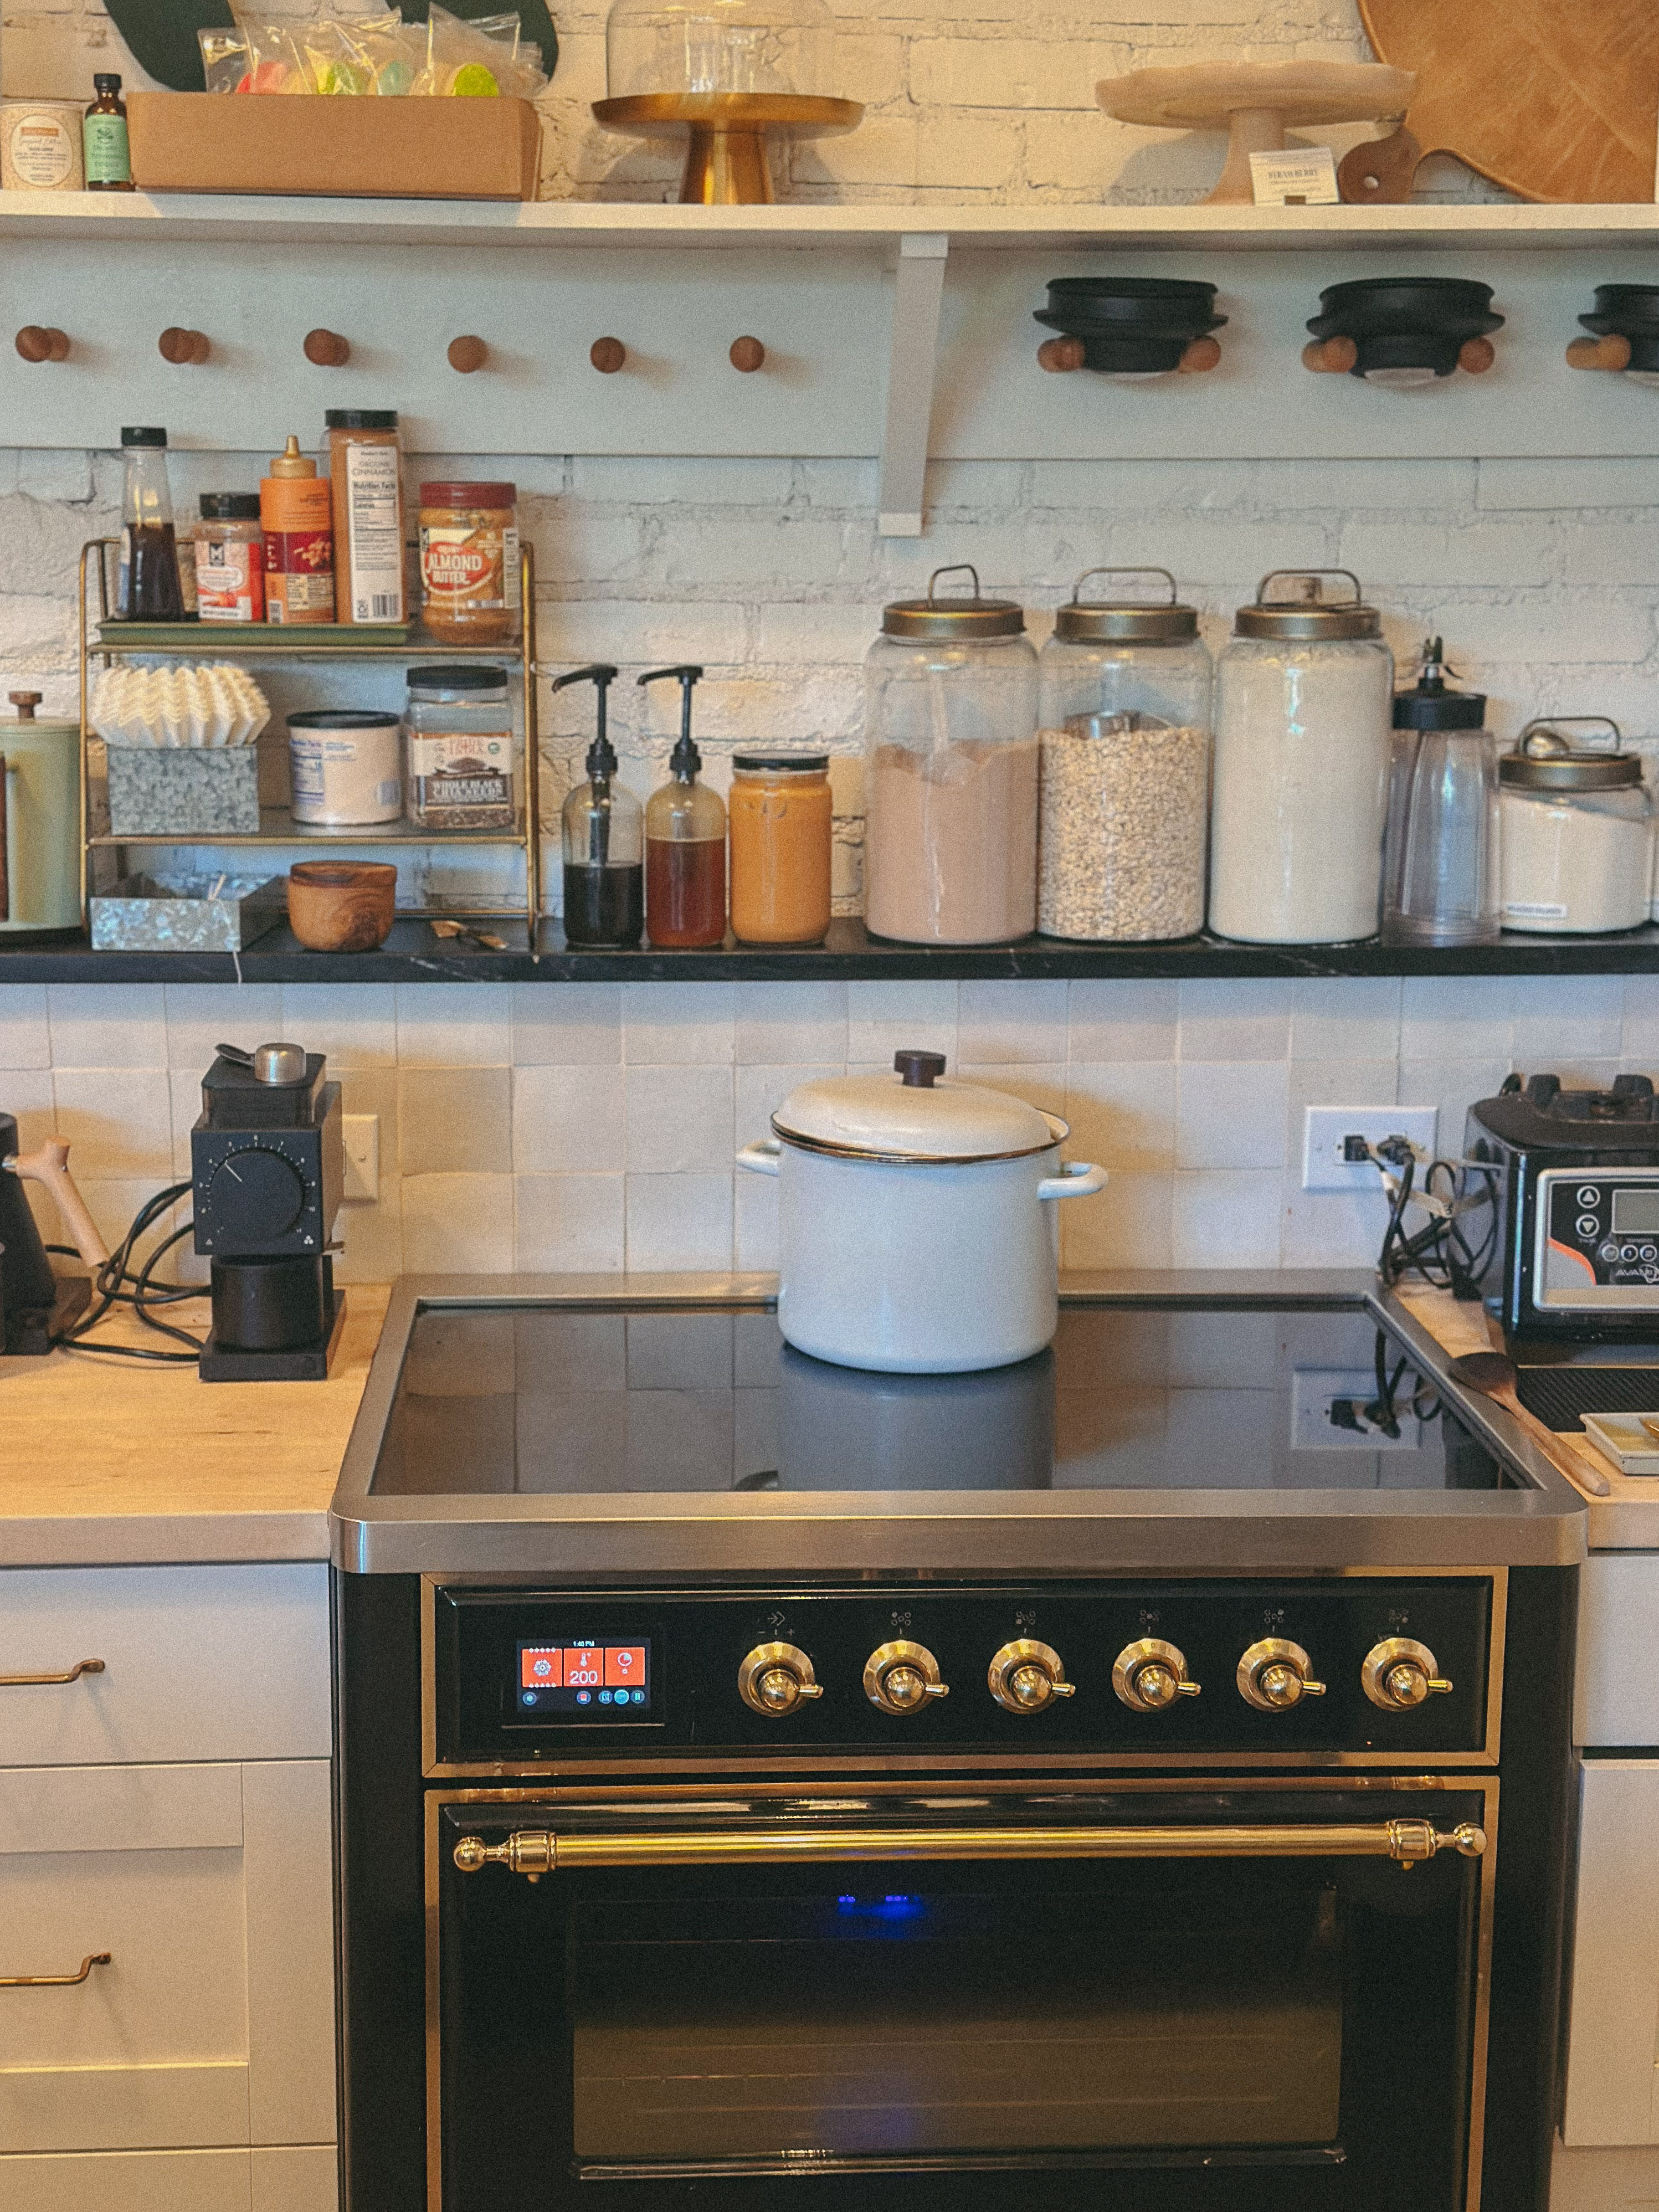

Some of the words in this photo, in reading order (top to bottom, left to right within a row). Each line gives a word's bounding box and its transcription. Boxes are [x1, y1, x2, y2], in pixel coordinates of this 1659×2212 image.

[426, 553, 483, 572] ALMOND
[432, 571, 470, 585] BUTTER
[569, 1670, 599, 1685] 200
